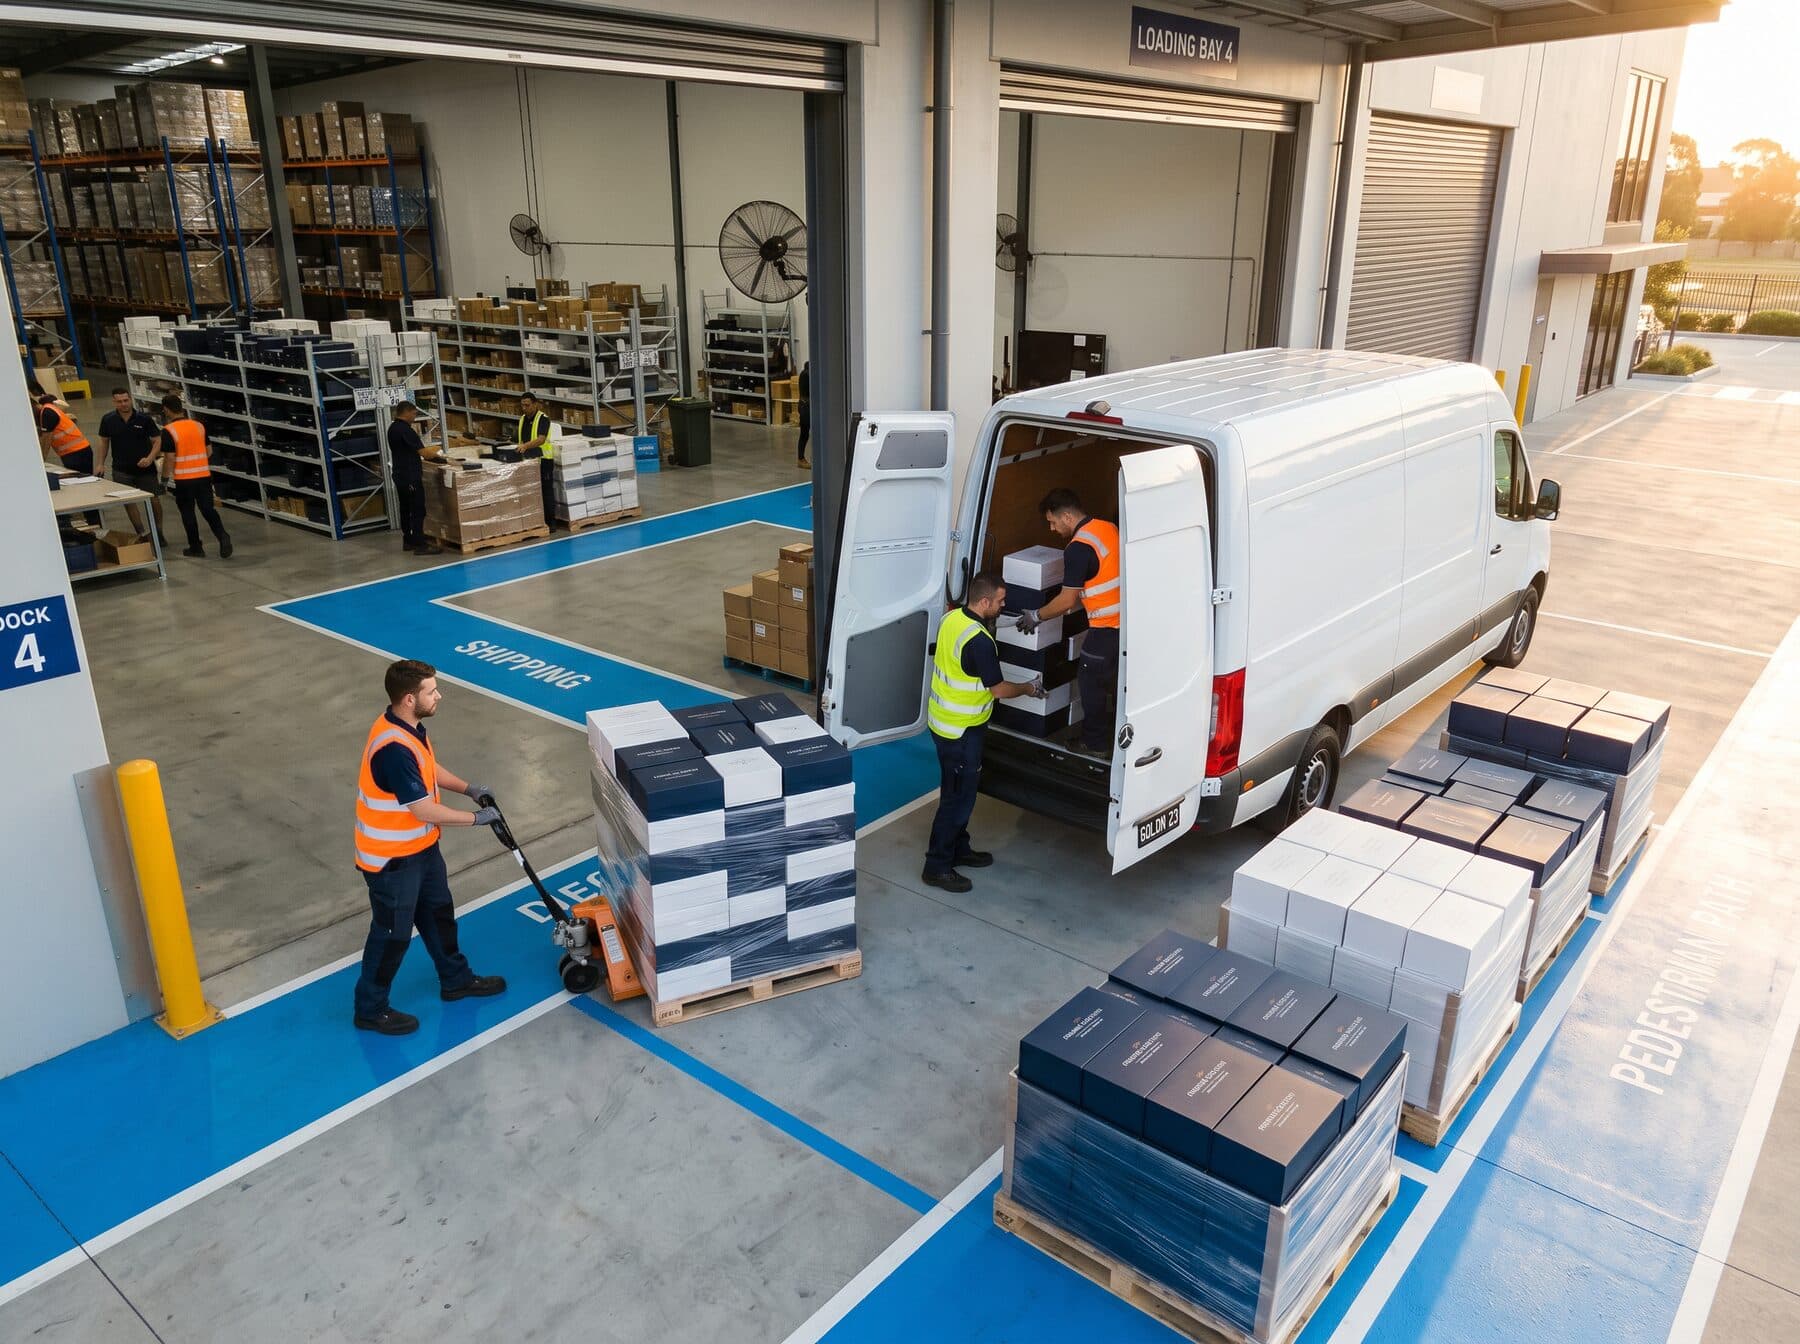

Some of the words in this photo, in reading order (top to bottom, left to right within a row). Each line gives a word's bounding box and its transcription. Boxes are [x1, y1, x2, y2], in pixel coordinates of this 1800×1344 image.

[1138, 25, 1196, 58] LOADING
[1199, 36, 1223, 61] BAY
[1224, 42, 1233, 63] 4
[14, 632, 46, 673] 4
[454, 640, 592, 690] SHIPPING
[1140, 814, 1167, 842] GOLDN
[1168, 808, 1179, 827] 23
[1609, 929, 1729, 1095] PEDESTRIAN
[1690, 872, 1752, 929] PATH
